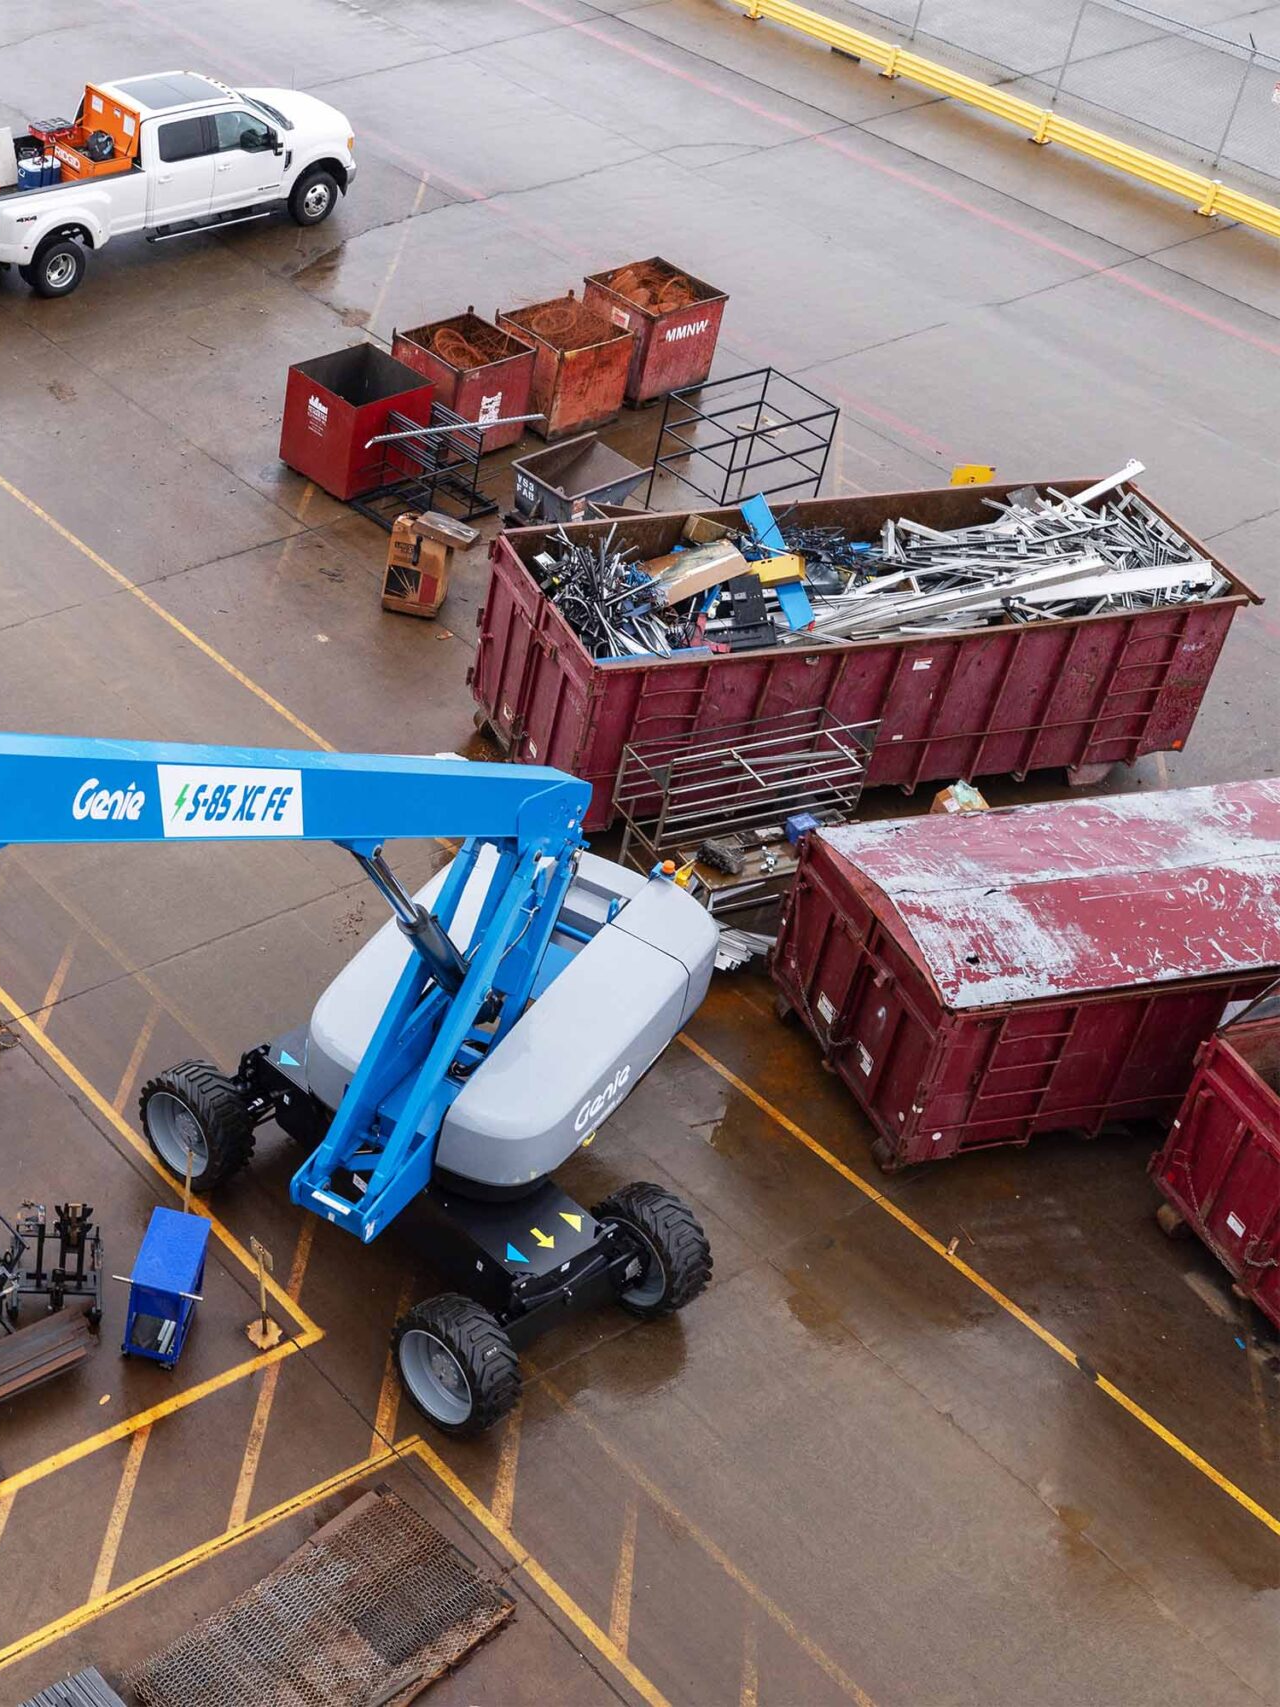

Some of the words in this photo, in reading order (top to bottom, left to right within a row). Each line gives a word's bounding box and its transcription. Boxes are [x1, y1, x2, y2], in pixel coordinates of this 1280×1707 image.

[665, 319, 709, 342] MMNW
[72, 777, 146, 821] Genie
[184, 783, 238, 822] S-85
[232, 784, 266, 822] XC
[261, 786, 294, 822] FE
[574, 1064, 631, 1132] Genie
